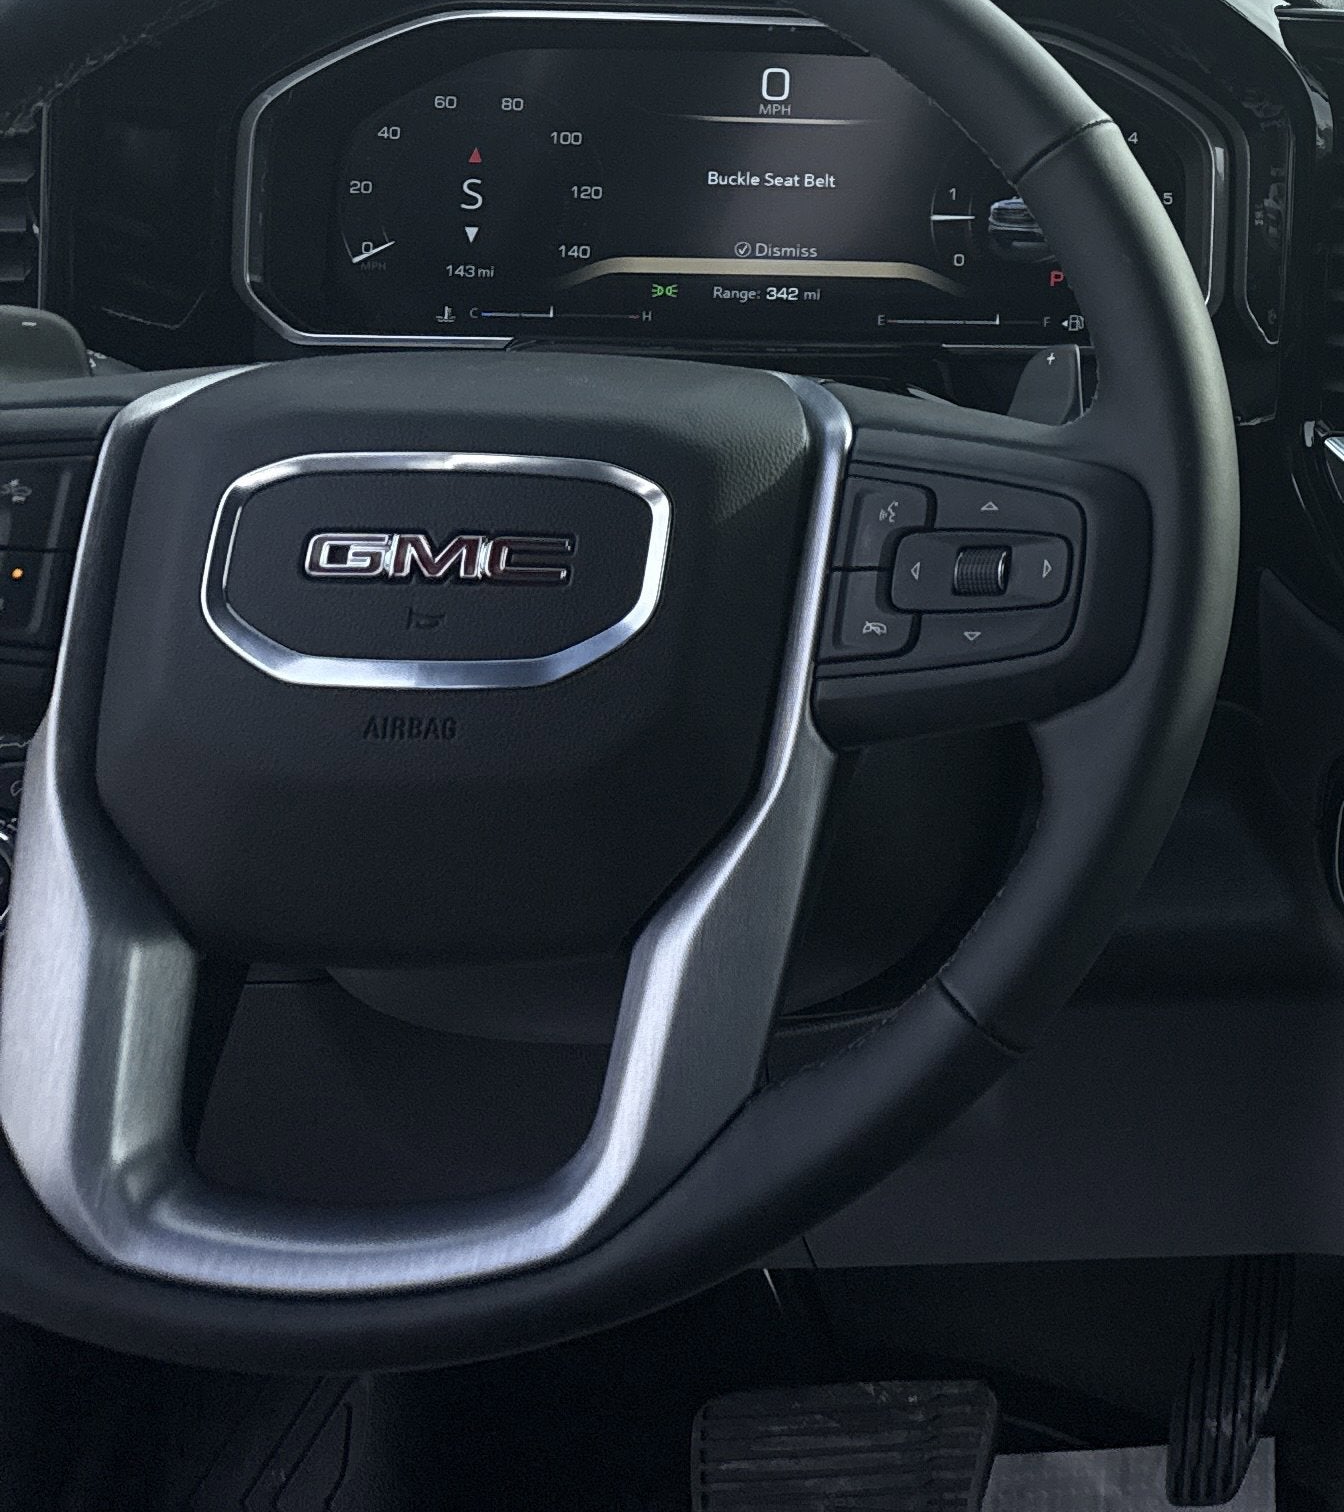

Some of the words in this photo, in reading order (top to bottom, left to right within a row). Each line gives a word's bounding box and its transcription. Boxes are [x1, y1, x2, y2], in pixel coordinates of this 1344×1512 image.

[761, 67, 791, 101] 0
[434, 96, 457, 109] 60
[501, 98, 524, 111] 80
[758, 104, 792, 117] MPH
[377, 126, 400, 139] 40
[550, 131, 582, 145] 100
[1127, 132, 1139, 144] 4
[707, 171, 760, 186] Buckle
[763, 173, 800, 188] Seat
[804, 174, 836, 188] Belt
[350, 180, 372, 194] 20
[571, 186, 603, 200] 120
[460, 178, 483, 210] S
[949, 188, 957, 200] 1
[1162, 193, 1173, 206] 5
[558, 246, 591, 259] 140
[755, 243, 818, 258] Dismiss
[953, 254, 965, 267] 0
[446, 265, 476, 278] 143
[477, 266, 495, 278] mi
[1049, 271, 1064, 287] P
[712, 287, 761, 303] Range:
[765, 288, 799, 302] 342
[803, 289, 821, 302] mi
[642, 311, 652, 322] H
[877, 315, 886, 327] E
[1043, 317, 1051, 328] F
[304, 532, 572, 581] GMC
[362, 715, 457, 741] AIRBAG
